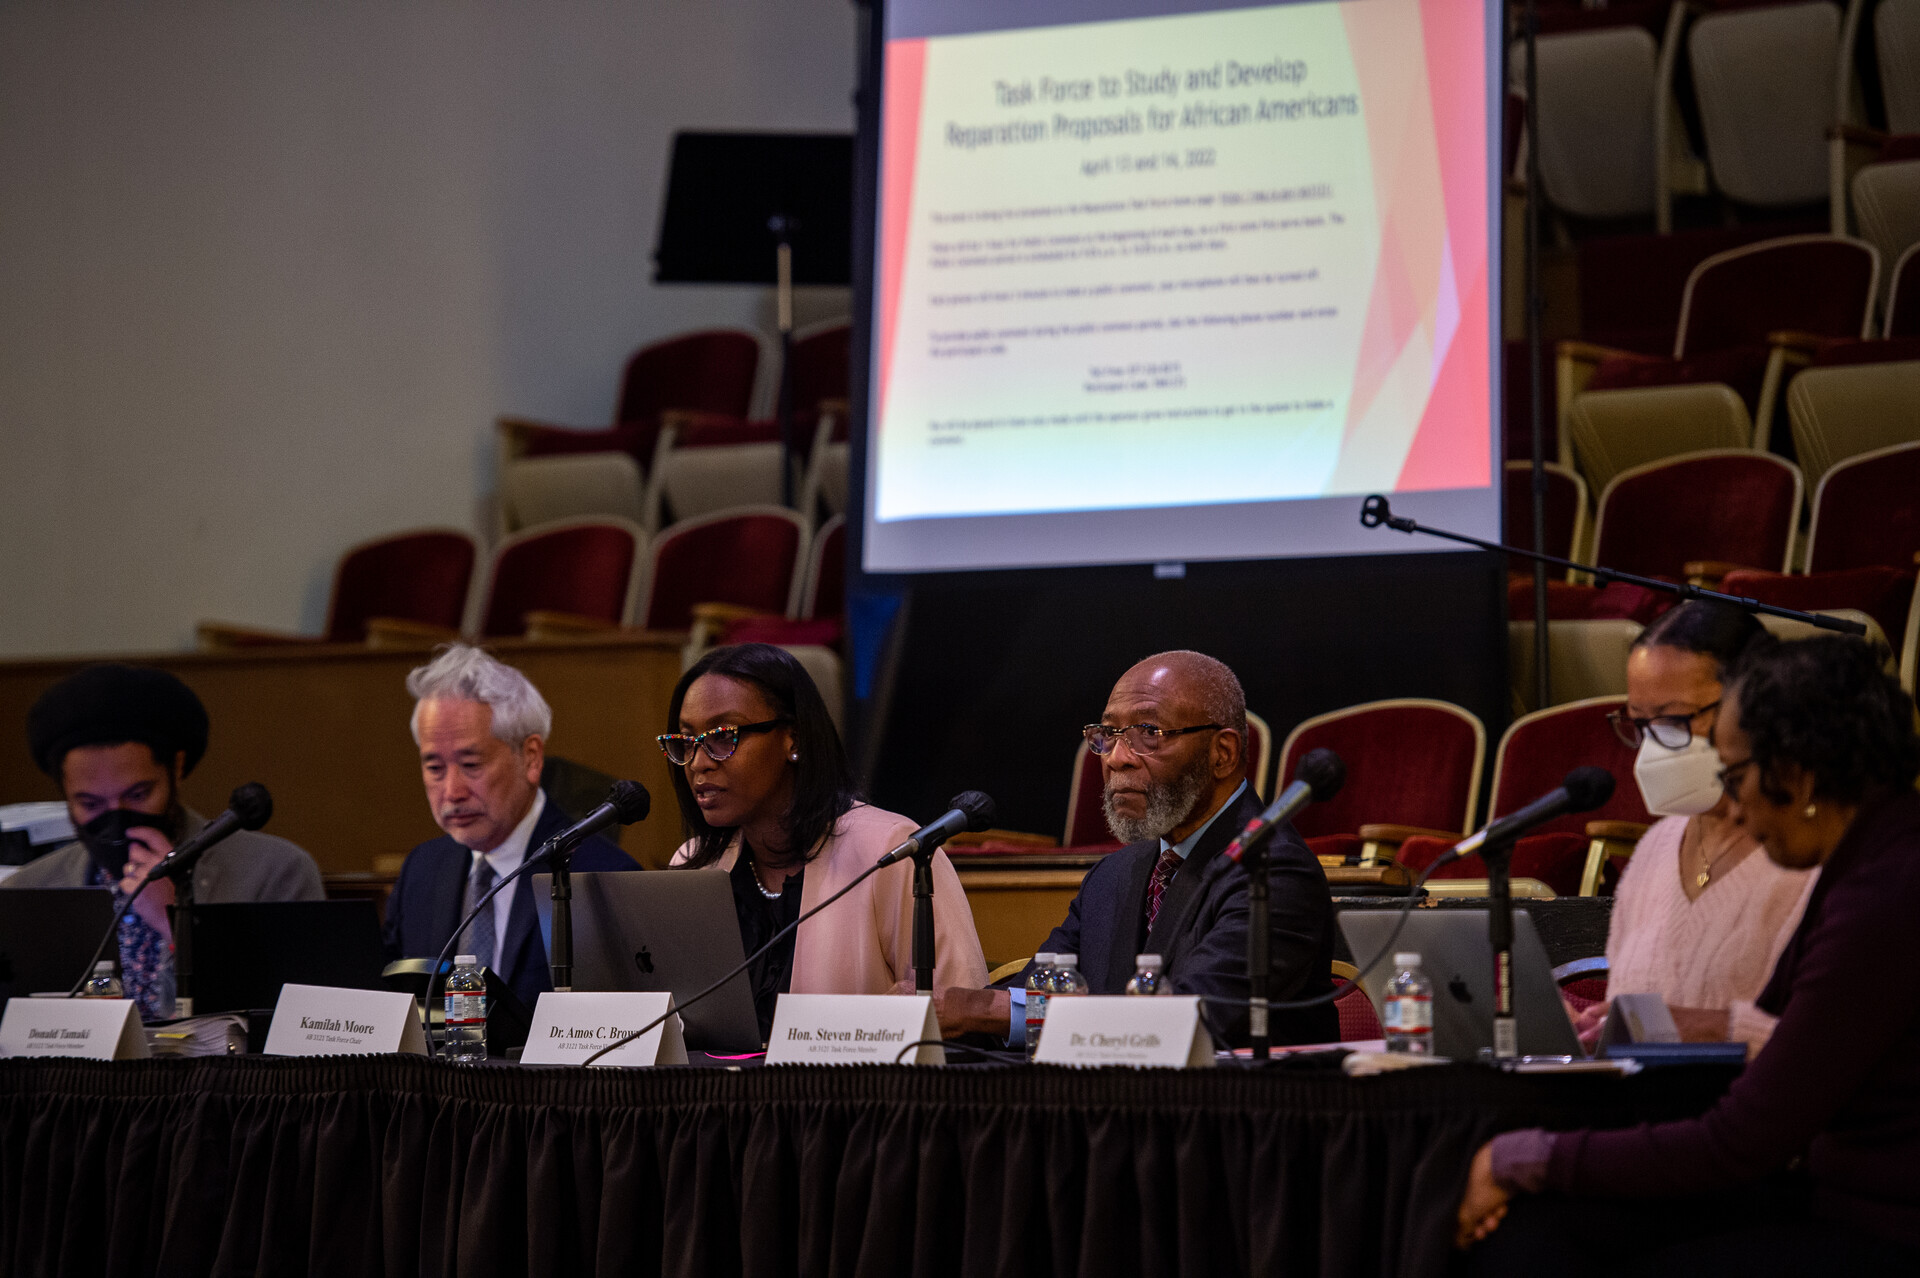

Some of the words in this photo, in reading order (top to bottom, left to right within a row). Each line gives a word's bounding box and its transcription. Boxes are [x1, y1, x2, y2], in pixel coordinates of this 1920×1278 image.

[994, 79, 1034, 107] Task
[1039, 76, 1095, 103] Force
[1099, 75, 1120, 98] to
[1124, 65, 1180, 97] Study
[1184, 60, 1222, 91] and
[1226, 55, 1307, 87] Develop
[946, 121, 1048, 151] Reparation
[1052, 111, 1143, 141] Proposals
[1147, 105, 1175, 132] for
[1180, 101, 1250, 128] African
[1255, 93, 1359, 122] Americans
[1135, 153, 1157, 171] and
[300, 1016, 341, 1032] Kamilah
[343, 1020, 375, 1035] Moore
[549, 1026, 564, 1039] Dr.
[566, 1026, 594, 1039] Amos
[596, 1026, 607, 1039] C.
[28, 1029, 59, 1040] Donald
[60, 1029, 91, 1040] Tamaki
[326, 1035, 336, 1043] Task
[336, 1036, 349, 1044] Force
[349, 1037, 362, 1045] Chair
[787, 1028, 813, 1041] Hon.
[816, 1028, 850, 1041] Steven
[854, 1028, 905, 1042] Bradford
[1070, 1033, 1086, 1047] Dr.
[1089, 1033, 1128, 1050] Cheryl
